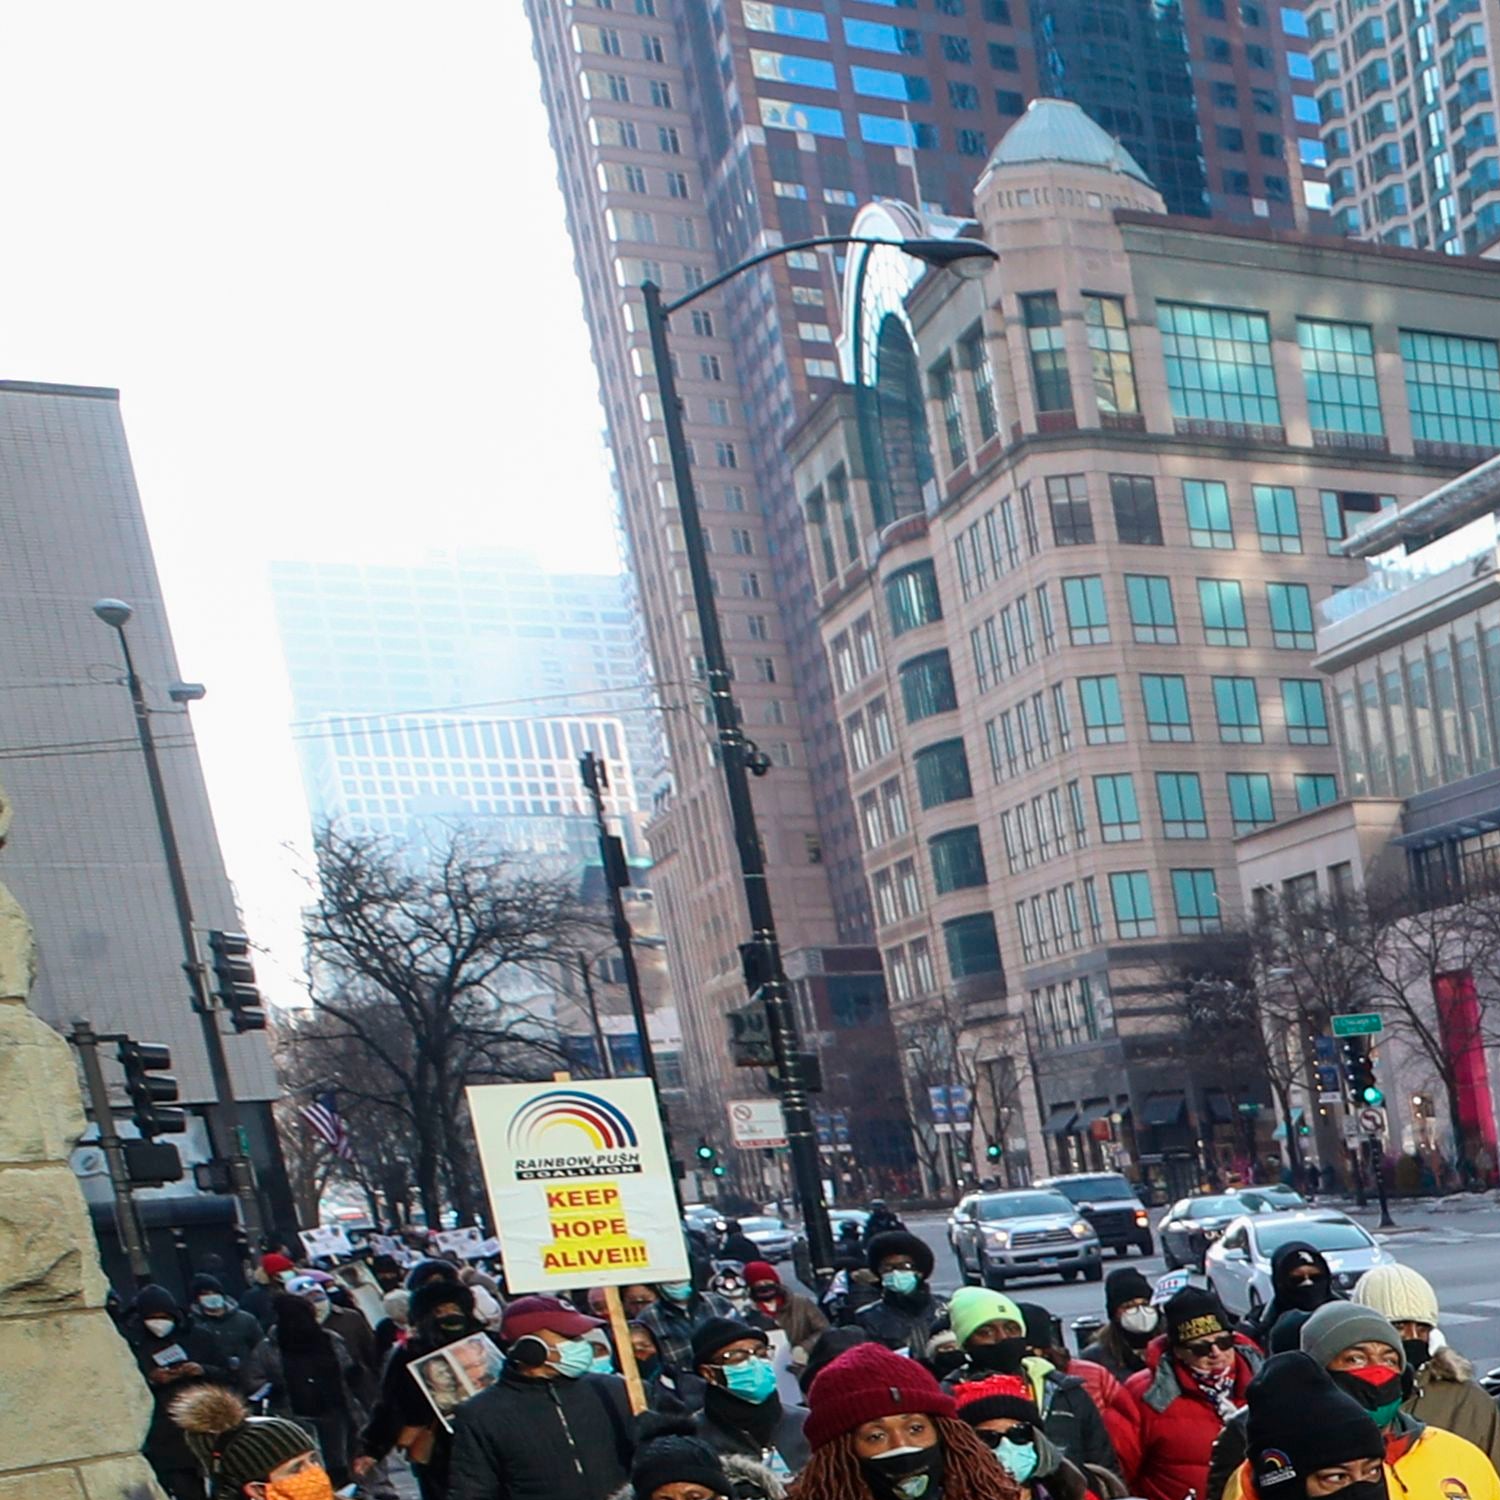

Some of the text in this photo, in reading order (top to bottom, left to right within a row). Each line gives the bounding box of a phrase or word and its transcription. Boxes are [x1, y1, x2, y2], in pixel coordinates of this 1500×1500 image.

[522, 1165, 635, 1179] COALITION
[546, 1188, 618, 1208] KEEP
[551, 1218, 627, 1239] HOPE
[543, 1246, 648, 1269] ALIVE!!!
